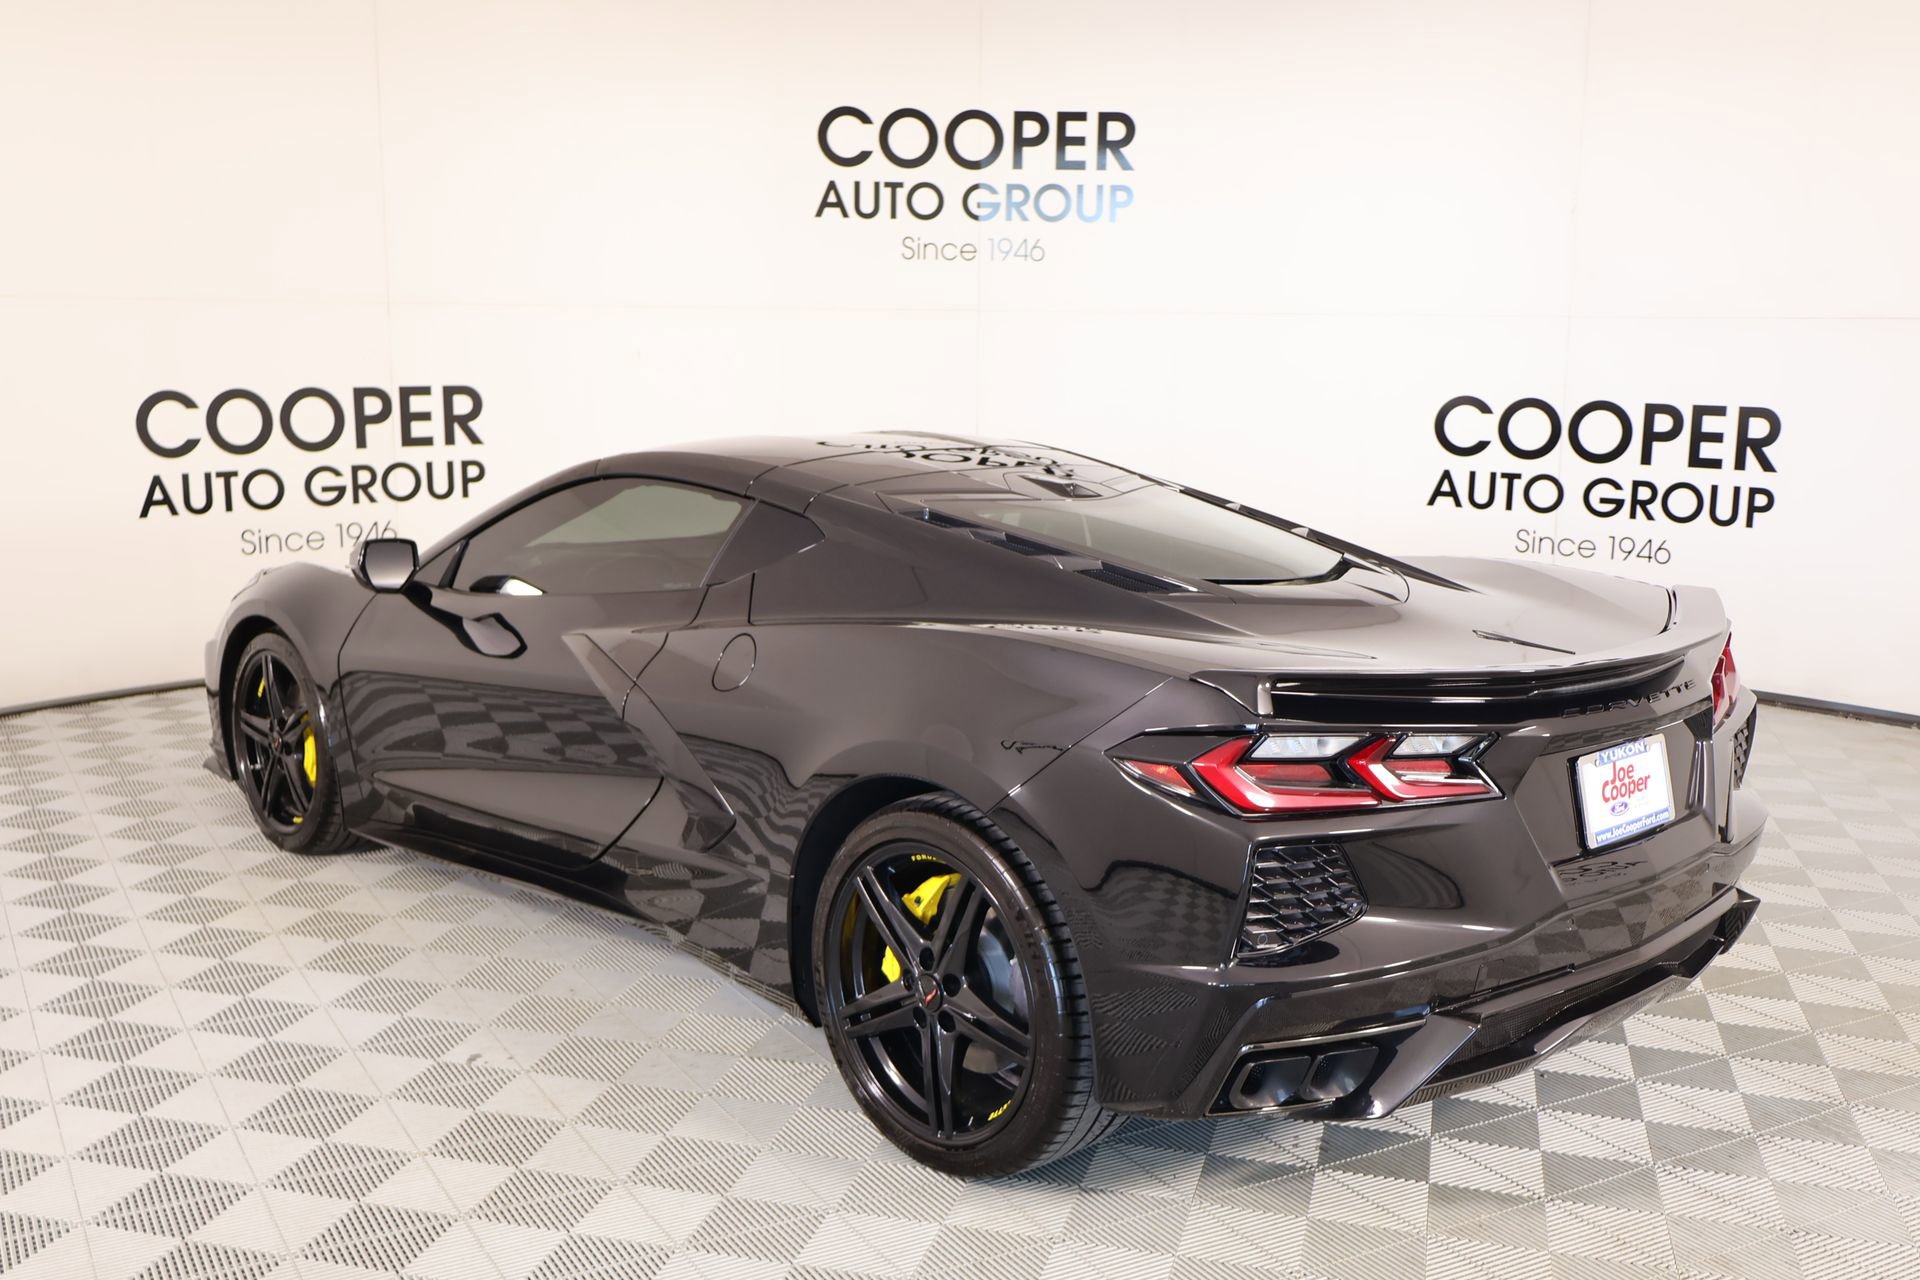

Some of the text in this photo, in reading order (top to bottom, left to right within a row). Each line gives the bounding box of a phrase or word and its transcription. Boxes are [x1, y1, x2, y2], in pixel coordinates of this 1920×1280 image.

[818, 106, 1136, 171] COOPER
[815, 180, 1134, 223] AUTO GROUP
[901, 236, 1046, 262] Since 1946
[135, 385, 484, 458] COOPER
[1434, 395, 1782, 473] COOPER
[139, 460, 486, 519] AUTO GROUP
[1426, 469, 1775, 528] AUTO GROUP
[241, 529, 325, 556] Since
[1514, 528, 1672, 565] Since 1946
[1562, 680, 1697, 718] CORVETTE
[1600, 742, 1645, 763] YUKON
[1602, 774, 1651, 803] Cooper
[1611, 761, 1635, 785] Joe
